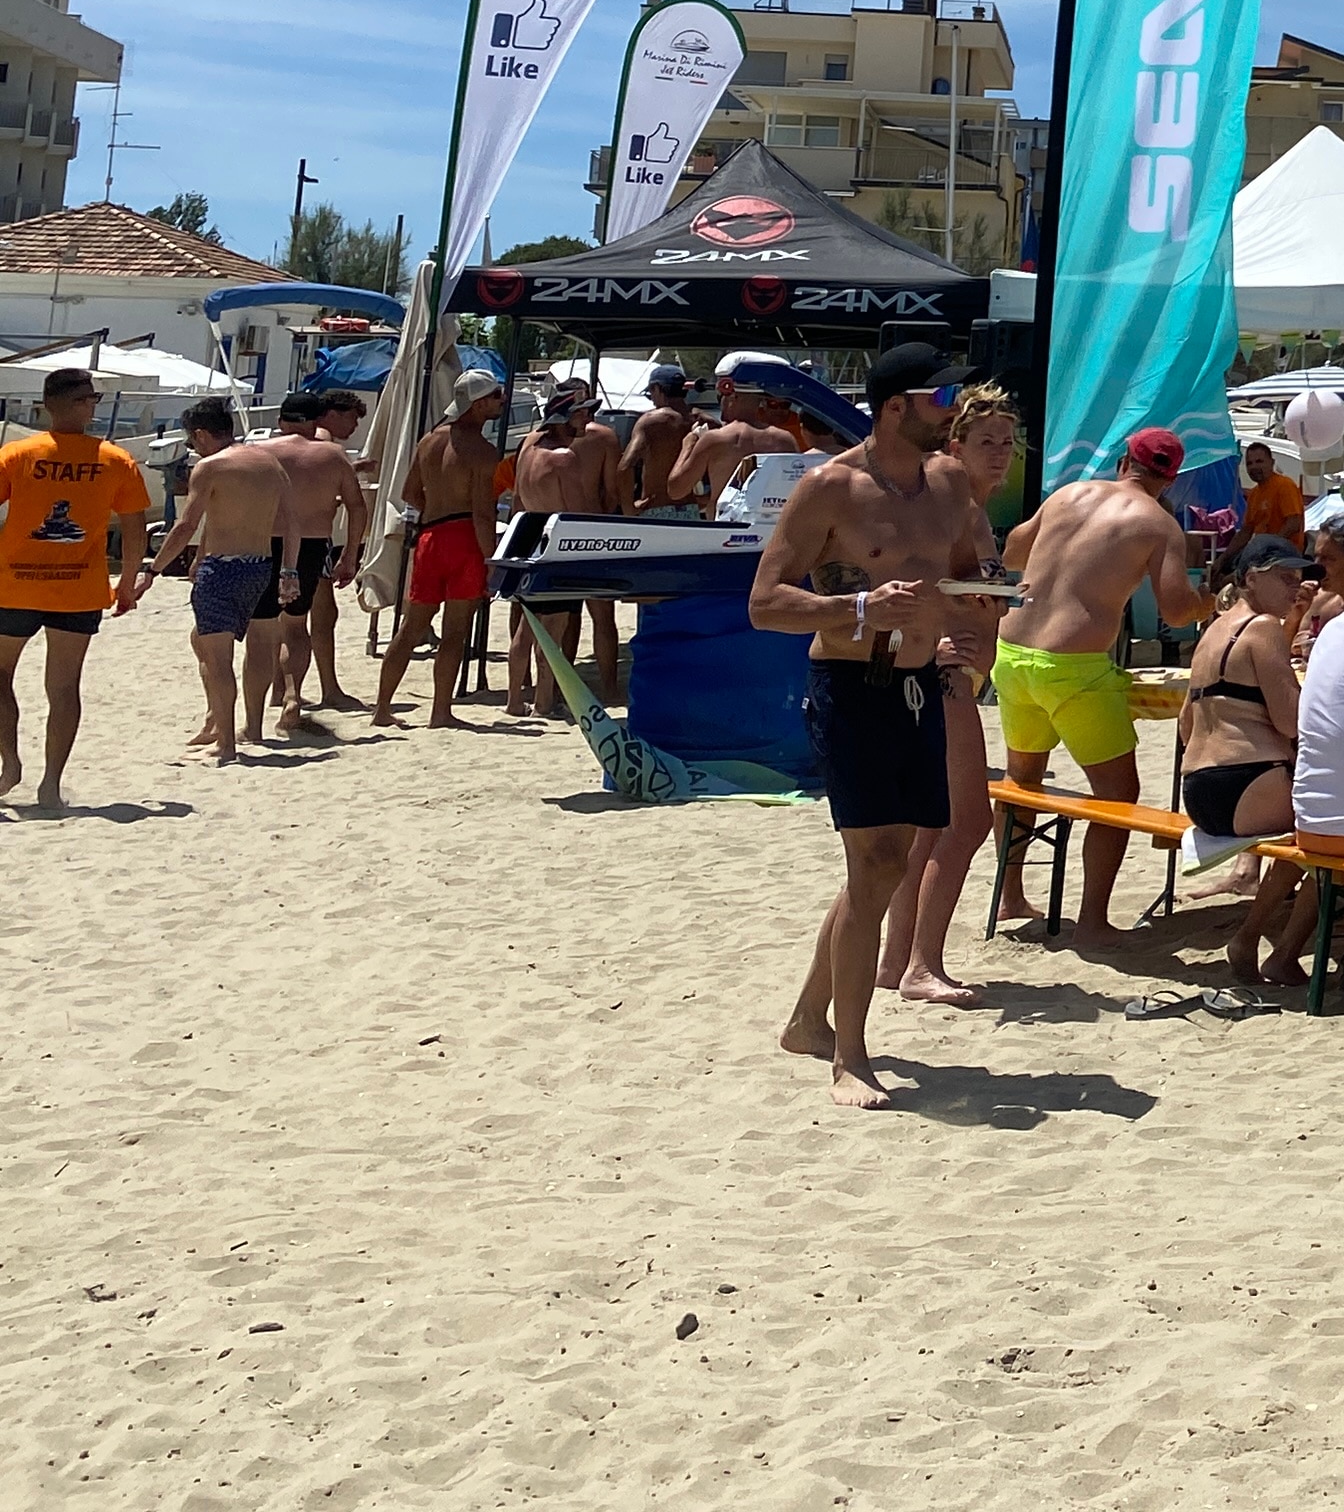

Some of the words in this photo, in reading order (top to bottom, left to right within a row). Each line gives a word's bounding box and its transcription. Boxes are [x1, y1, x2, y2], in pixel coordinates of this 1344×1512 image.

[485, 54, 539, 80] Like
[643, 49, 677, 64] Marina
[680, 57, 691, 66] Di
[694, 57, 728, 70] Rimini
[660, 64, 674, 76] Jet
[675, 66, 704, 79] Riders
[625, 166, 664, 185] Like
[650, 248, 811, 265] 24MX
[531, 277, 690, 306] 24MX
[792, 286, 944, 316] 24MX
[33, 459, 104, 482] STAFF
[558, 539, 641, 551] HYDRO-TURF
